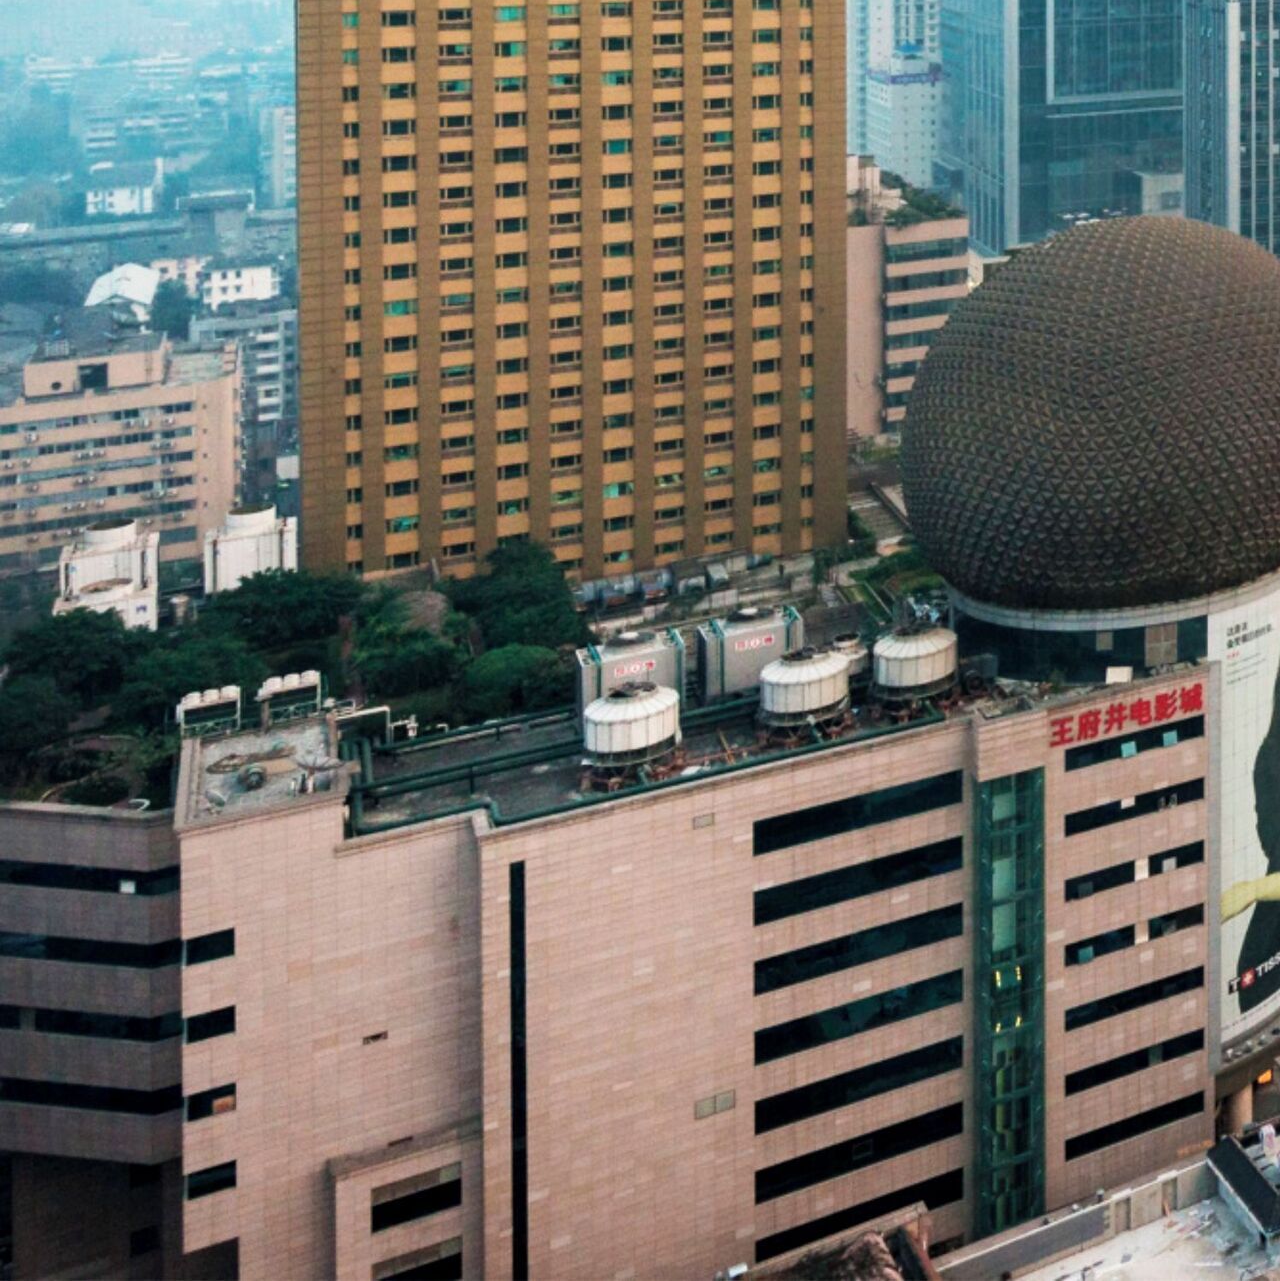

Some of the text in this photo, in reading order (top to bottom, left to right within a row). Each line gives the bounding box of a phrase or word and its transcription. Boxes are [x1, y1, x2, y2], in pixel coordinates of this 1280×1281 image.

[1049, 682, 1203, 748] 王府井电影城
